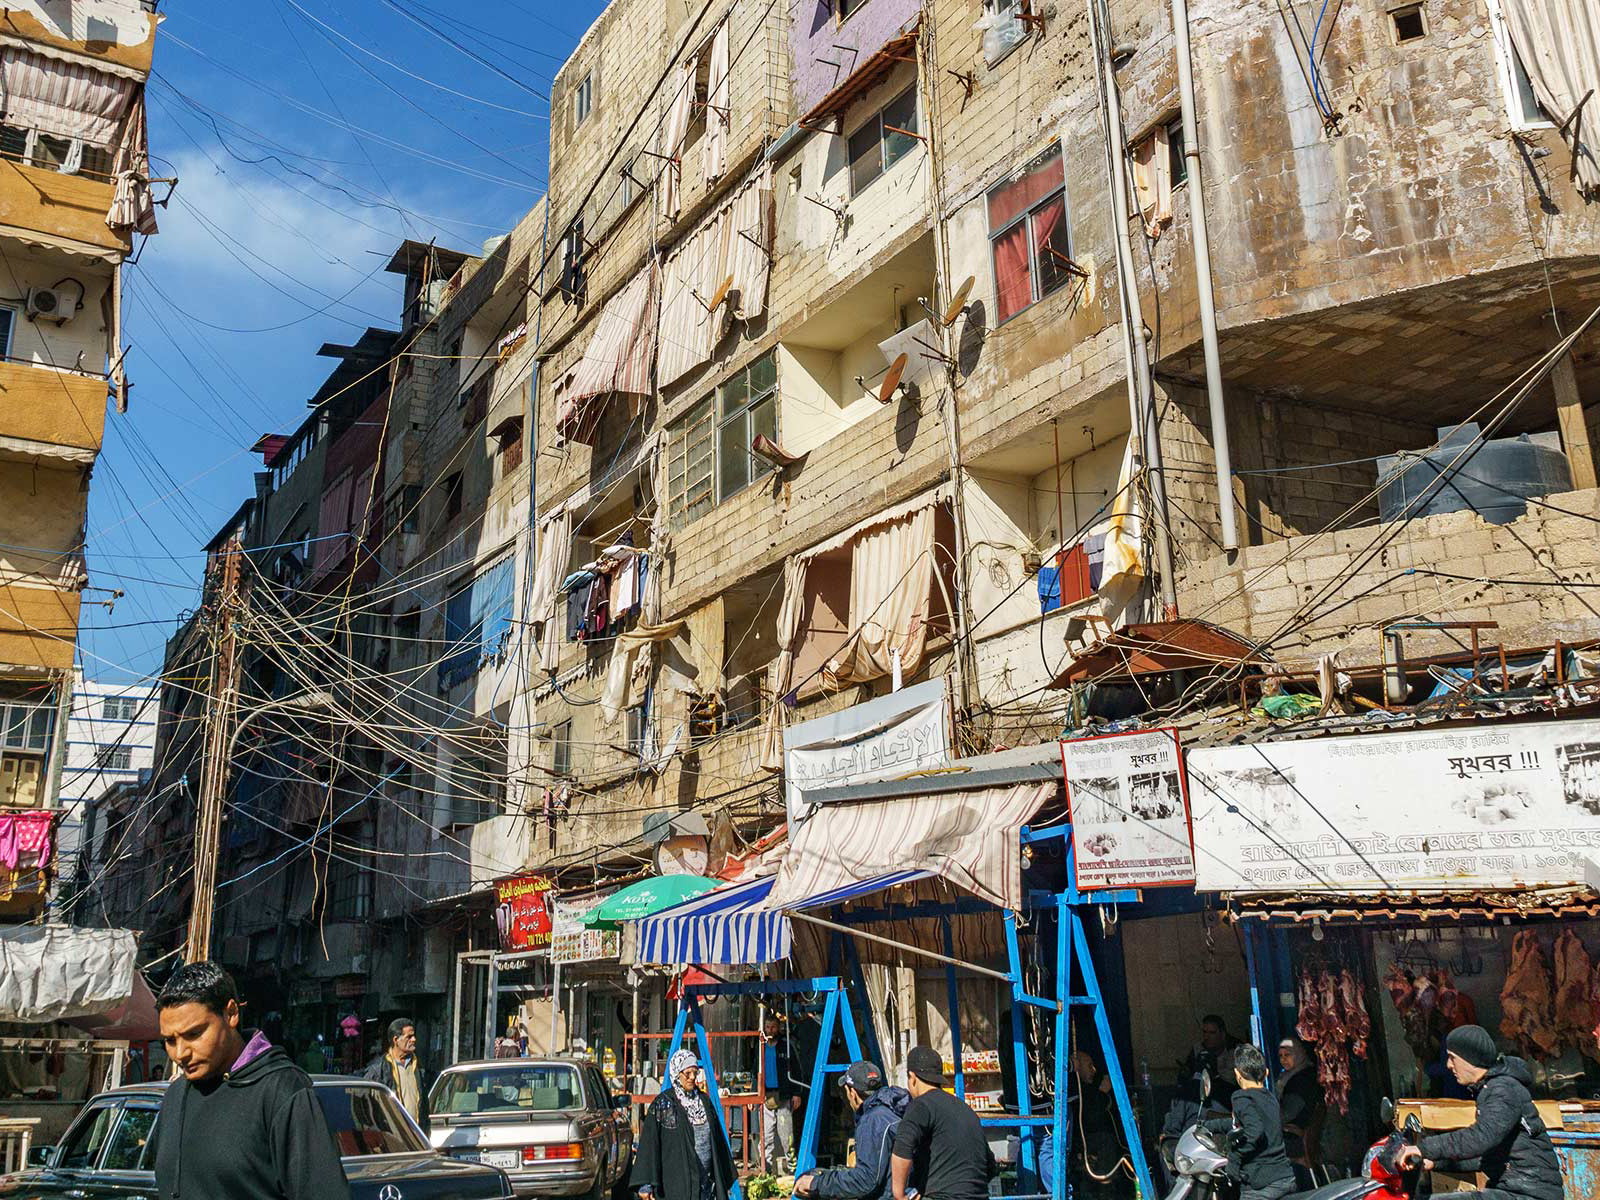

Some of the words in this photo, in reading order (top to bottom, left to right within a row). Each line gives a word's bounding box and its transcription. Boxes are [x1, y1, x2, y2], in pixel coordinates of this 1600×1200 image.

[1129, 753, 1158, 769] সুখবর
[1446, 754, 1512, 779] সুখবর
[1519, 751, 1541, 769] !!!
[1487, 829, 1536, 849] জন্য
[1241, 867, 1292, 882] এখানে
[1378, 859, 1419, 874] মাংস
[1480, 855, 1515, 872] যায়
